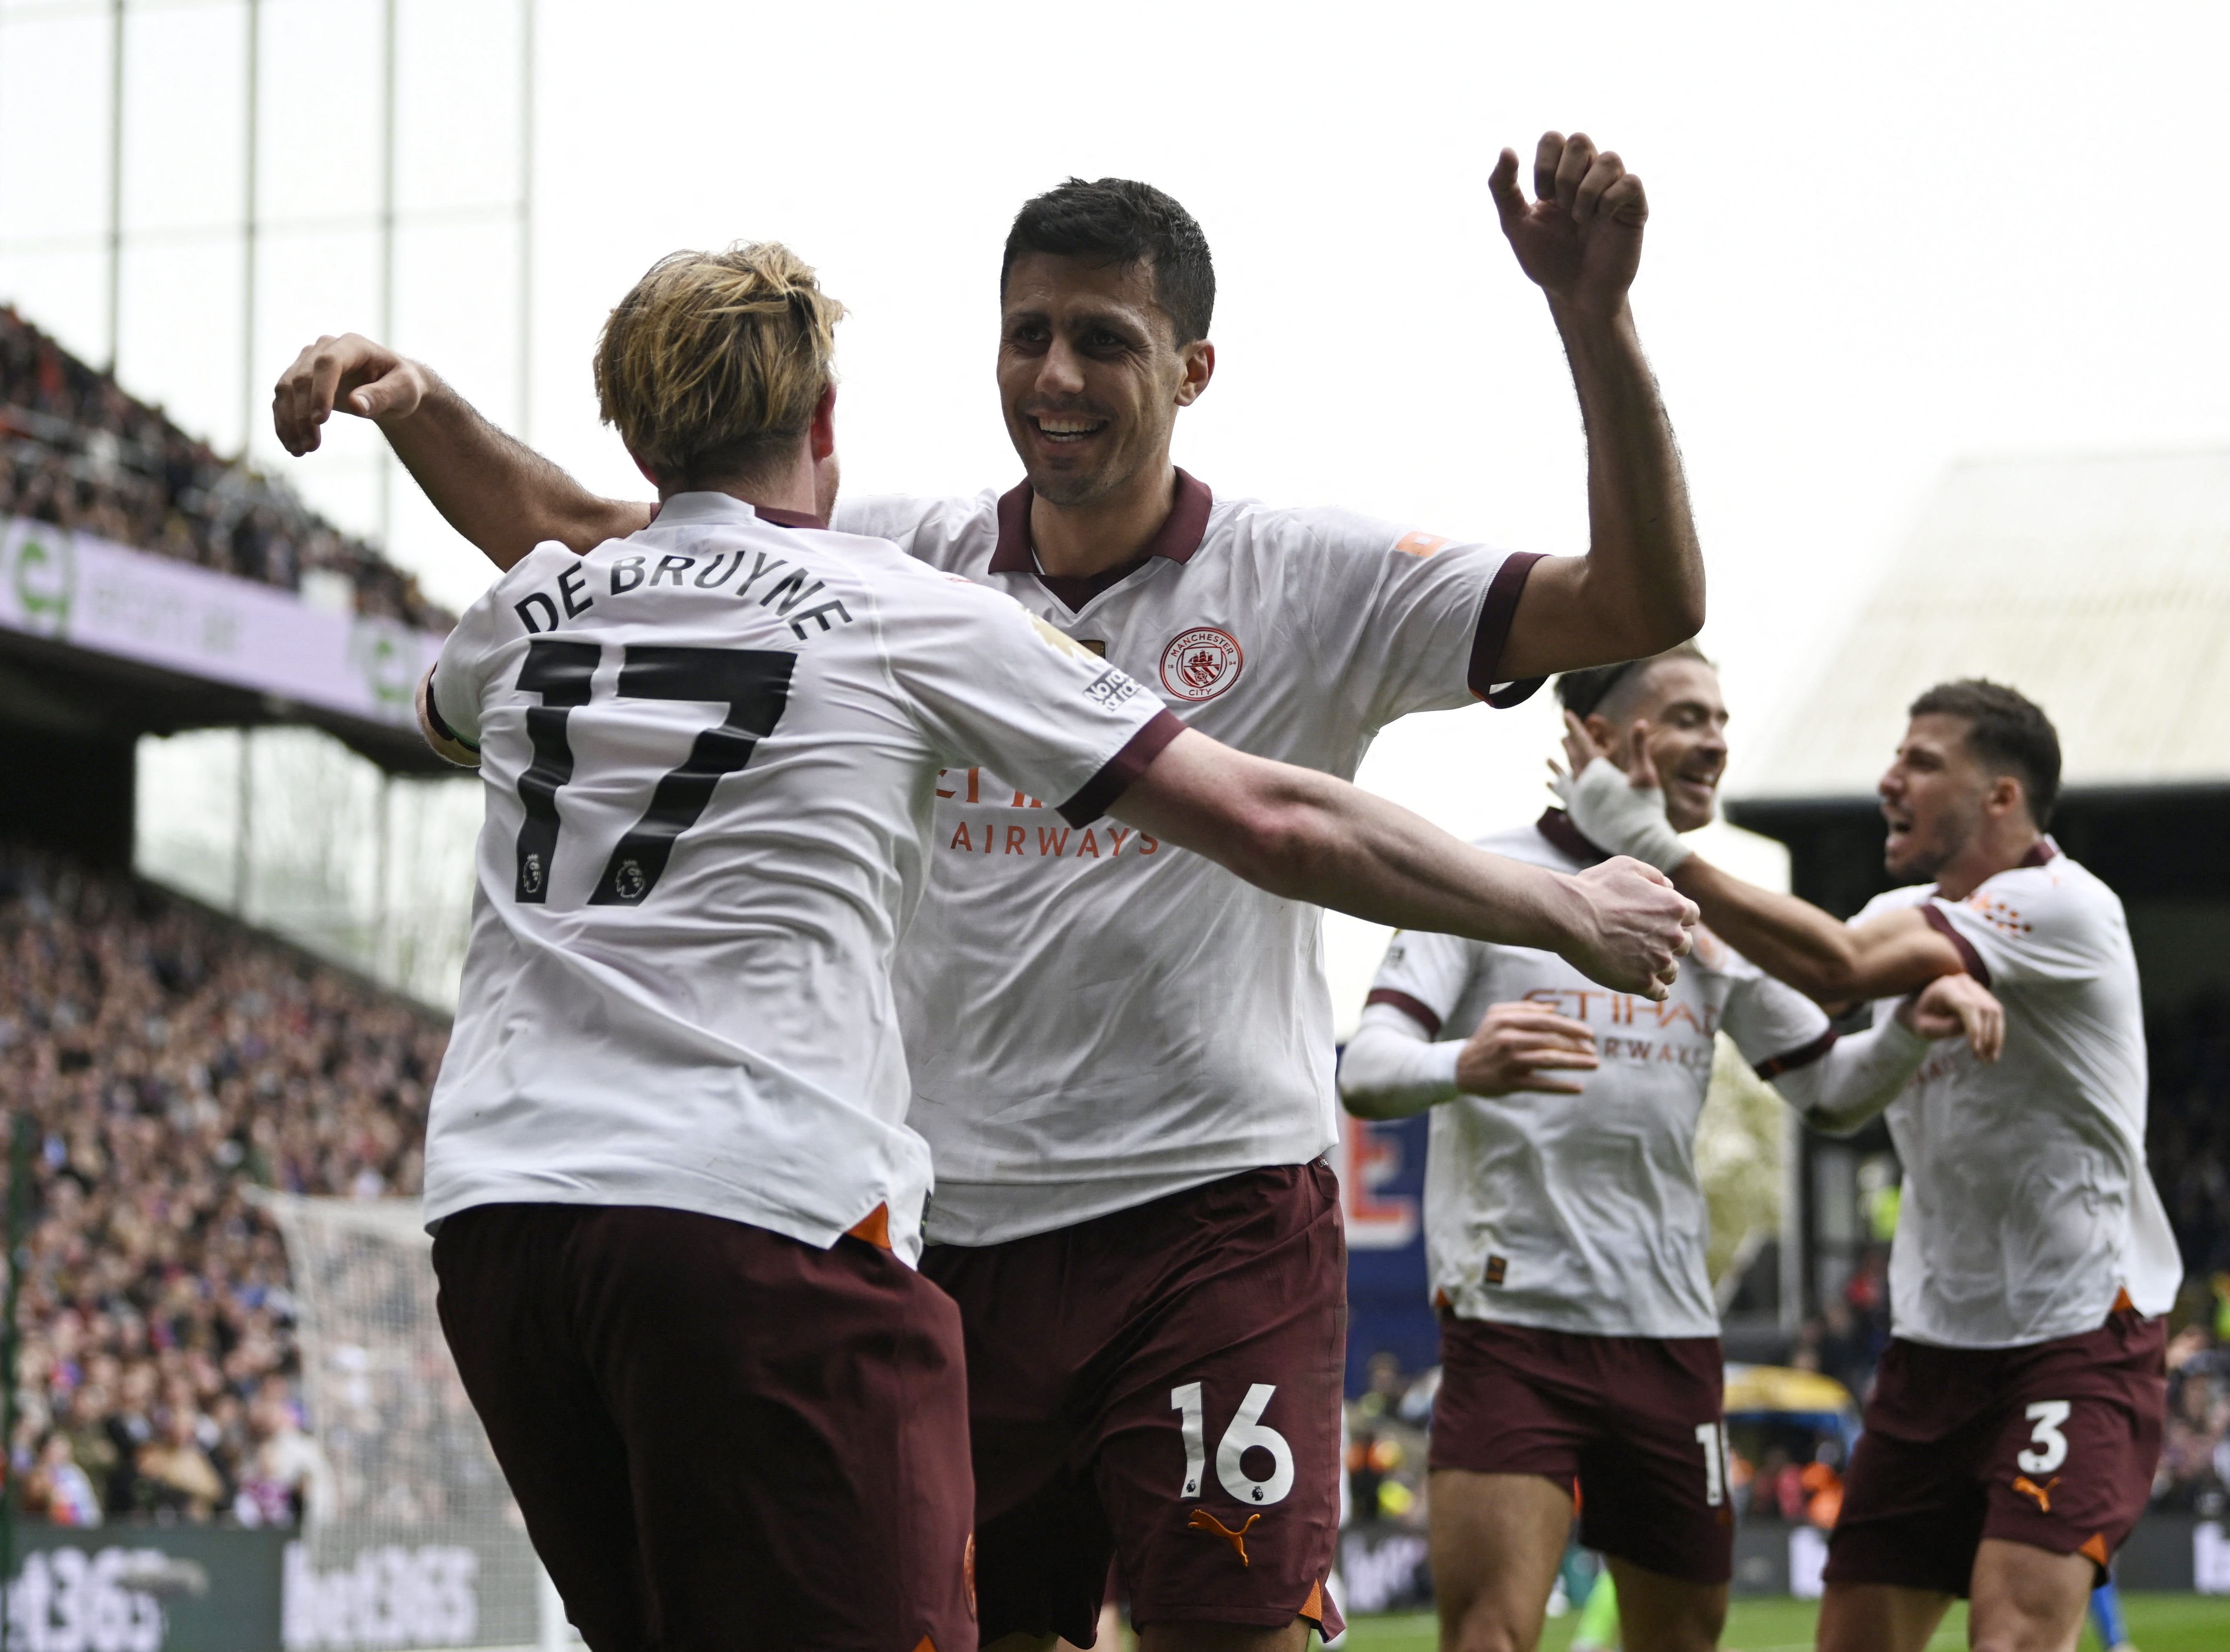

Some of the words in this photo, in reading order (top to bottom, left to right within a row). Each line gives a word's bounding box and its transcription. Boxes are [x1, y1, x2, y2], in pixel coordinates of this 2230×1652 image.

[513, 561, 594, 634] DE
[609, 550, 853, 640] BRUYNE
[1171, 633, 1234, 657] MANCHESTER
[514, 640, 798, 907] 17
[950, 821, 1158, 858] AIRWAYS
[1171, 1381, 1294, 1505] 16
[1695, 1421, 1732, 1507] 1
[2017, 1400, 2071, 1474] 3
